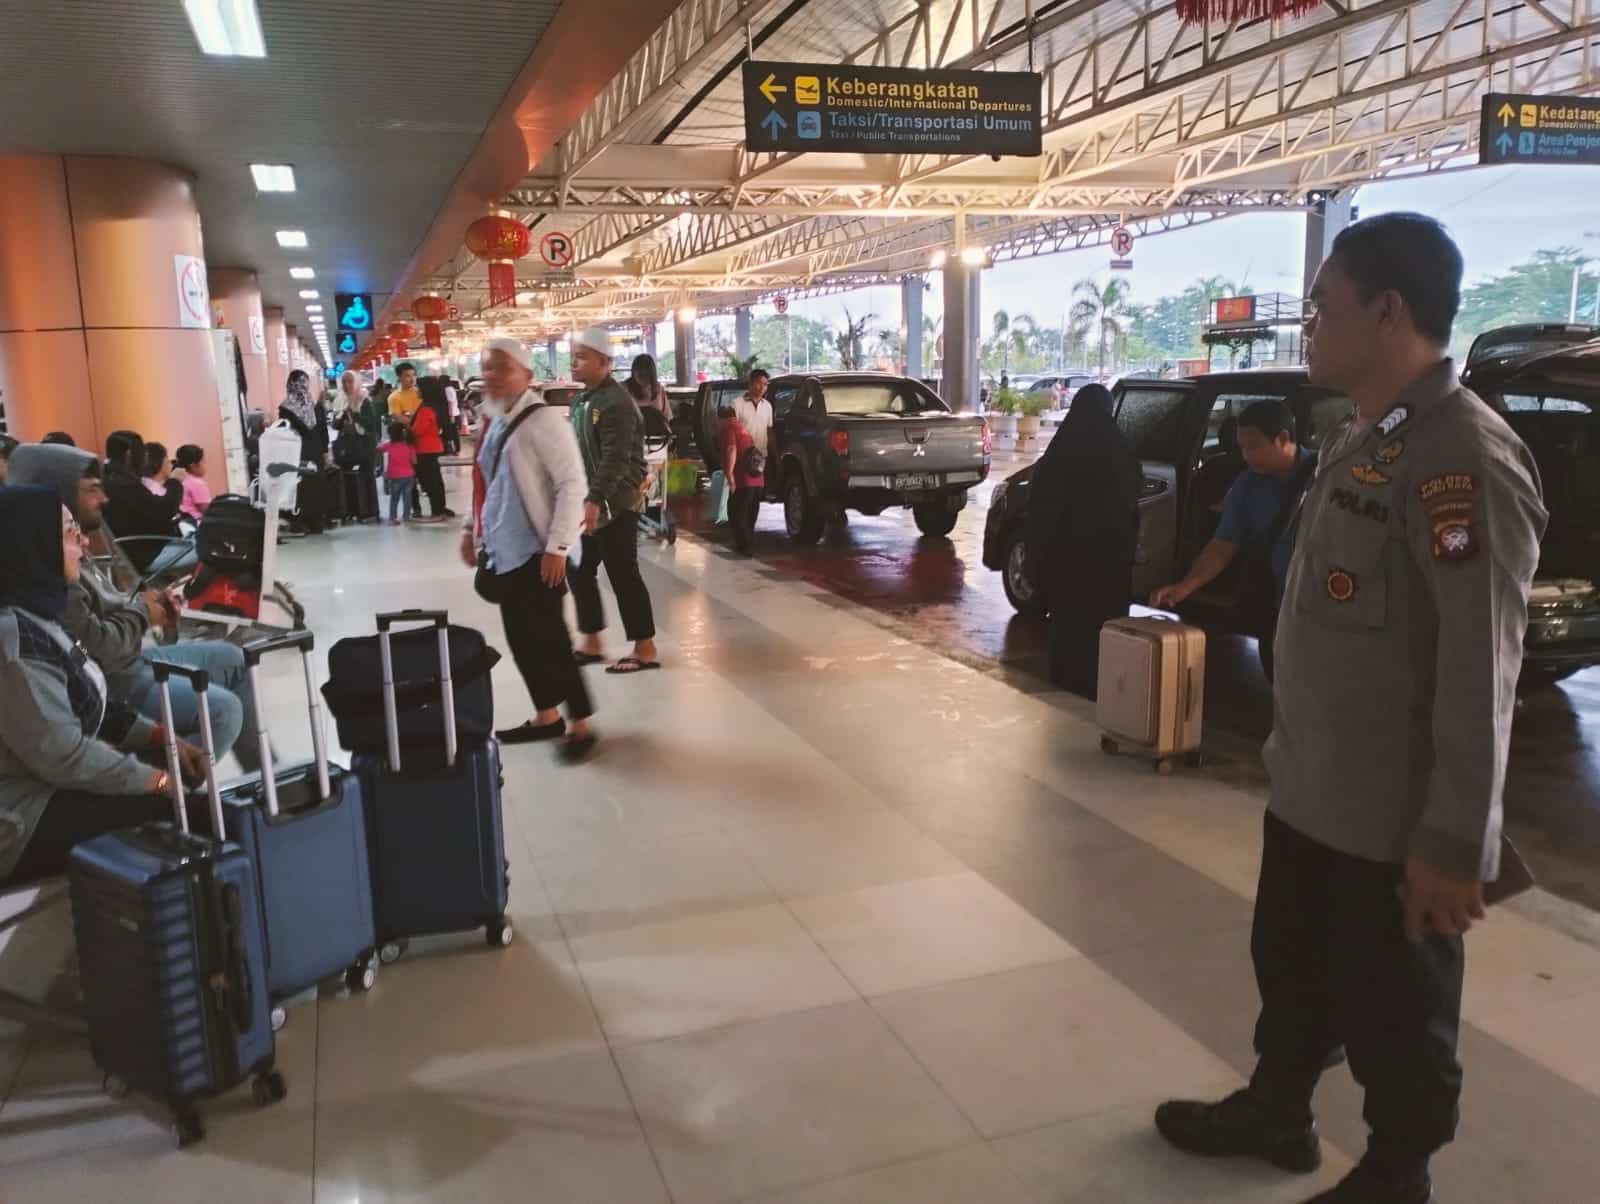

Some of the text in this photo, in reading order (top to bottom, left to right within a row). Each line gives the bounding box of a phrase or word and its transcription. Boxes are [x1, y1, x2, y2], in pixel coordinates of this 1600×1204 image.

[827, 76, 979, 100] Keberangkatan
[827, 95, 1032, 112] Domestic/International Departures
[828, 111, 1032, 131] Taksi/Transportasi Umum
[550, 238, 566, 261] P
